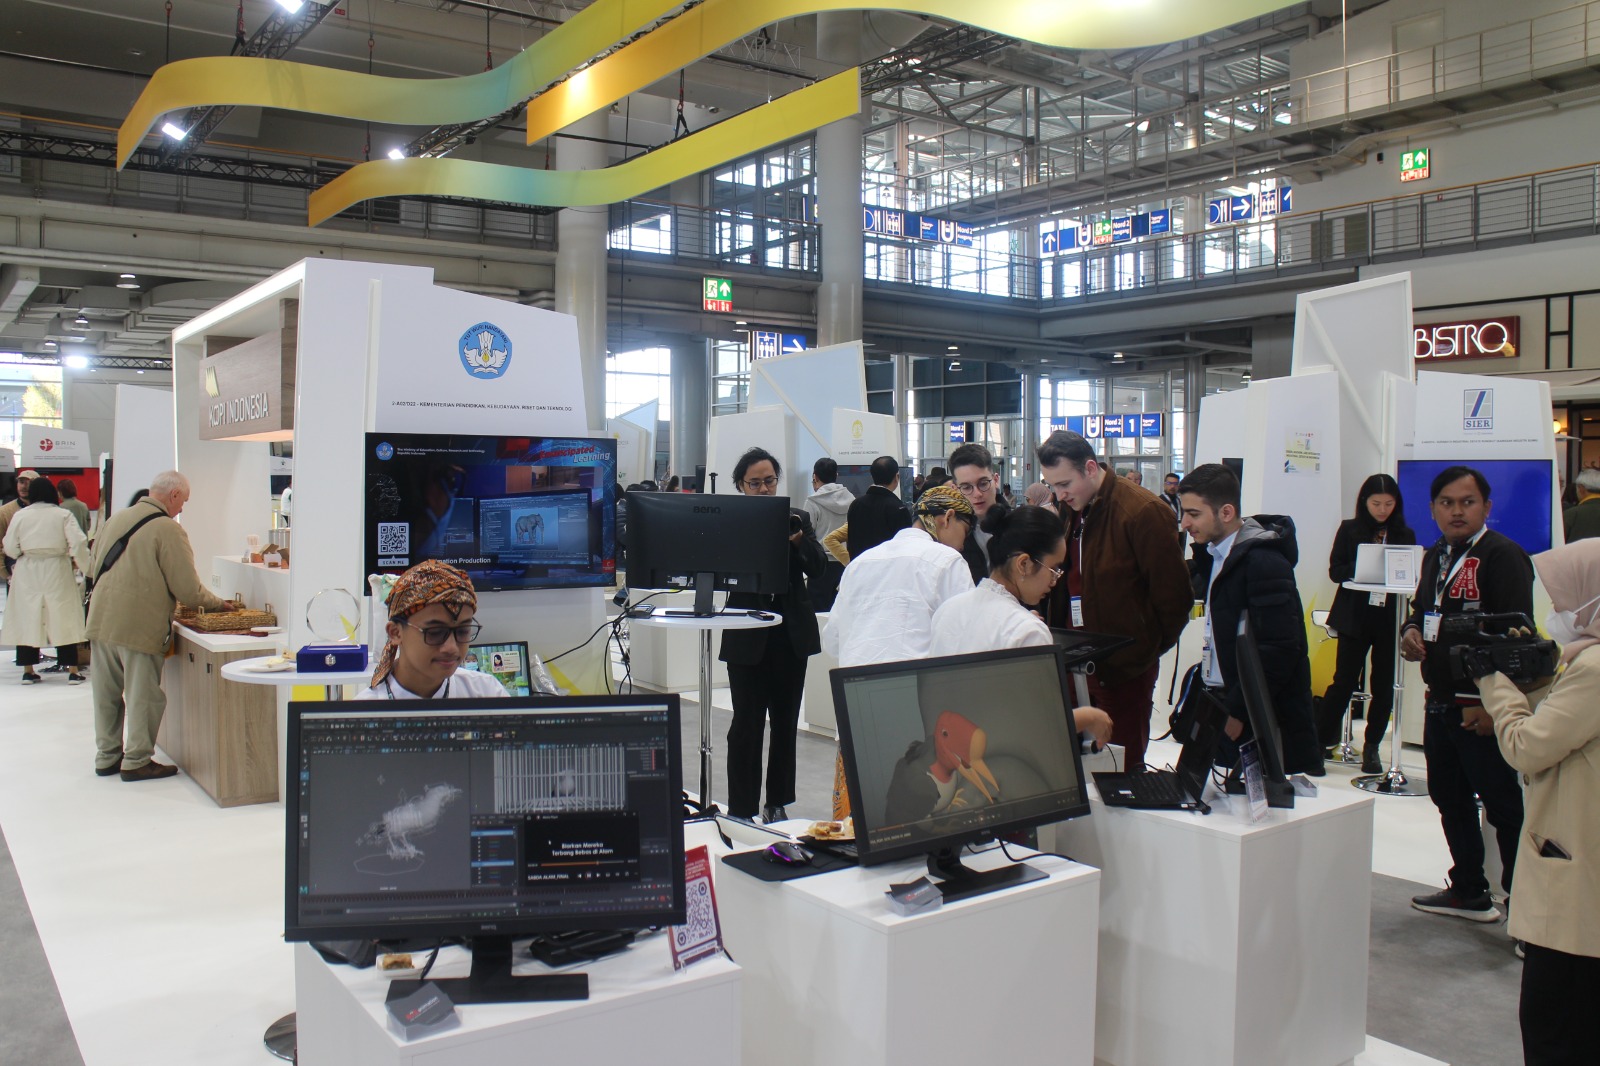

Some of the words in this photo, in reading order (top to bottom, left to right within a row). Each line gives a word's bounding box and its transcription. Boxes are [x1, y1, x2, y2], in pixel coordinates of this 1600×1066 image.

[1113, 220, 1126, 229] Nord
[1414, 322, 1508, 358] BISTRO
[227, 391, 269, 424] INDONESIA
[1104, 418, 1118, 426] Nord
[1128, 418, 1135, 433] 1
[1465, 420, 1490, 428] SIER
[573, 452, 611, 464] Learning
[458, 557, 491, 565] Production
